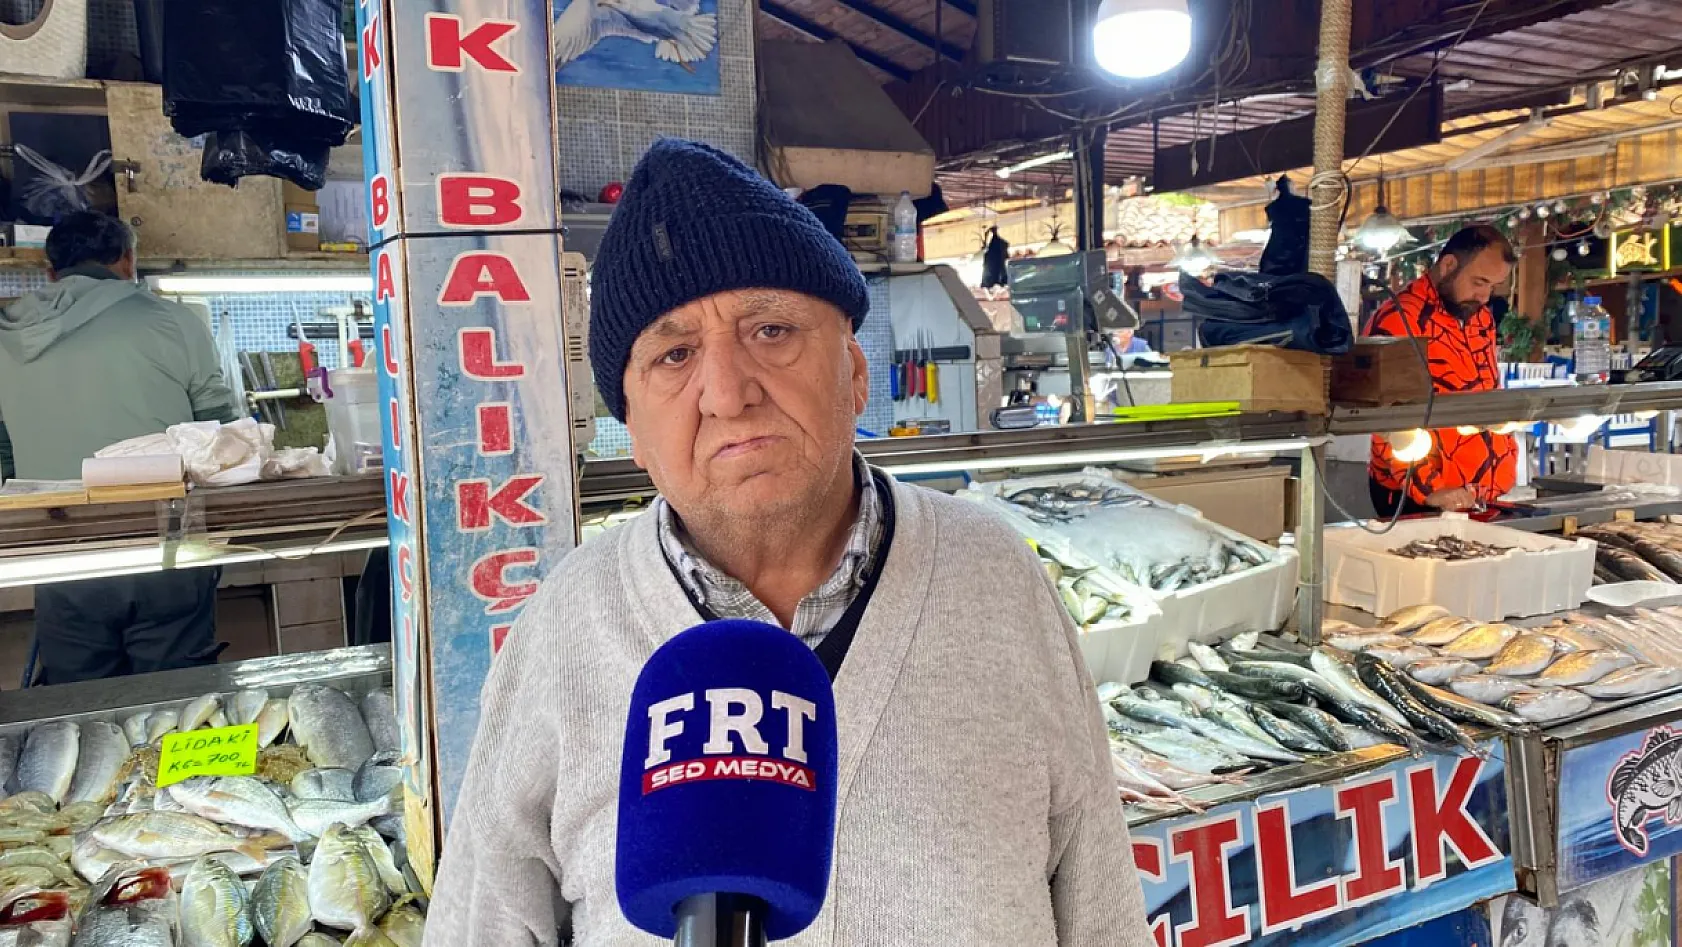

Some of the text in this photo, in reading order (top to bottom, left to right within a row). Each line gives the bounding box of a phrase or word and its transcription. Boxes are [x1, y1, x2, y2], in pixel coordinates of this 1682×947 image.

[645, 687, 816, 769] FRT
[651, 759, 810, 788] SED MEDYA
[1132, 756, 1504, 947] ILIK
